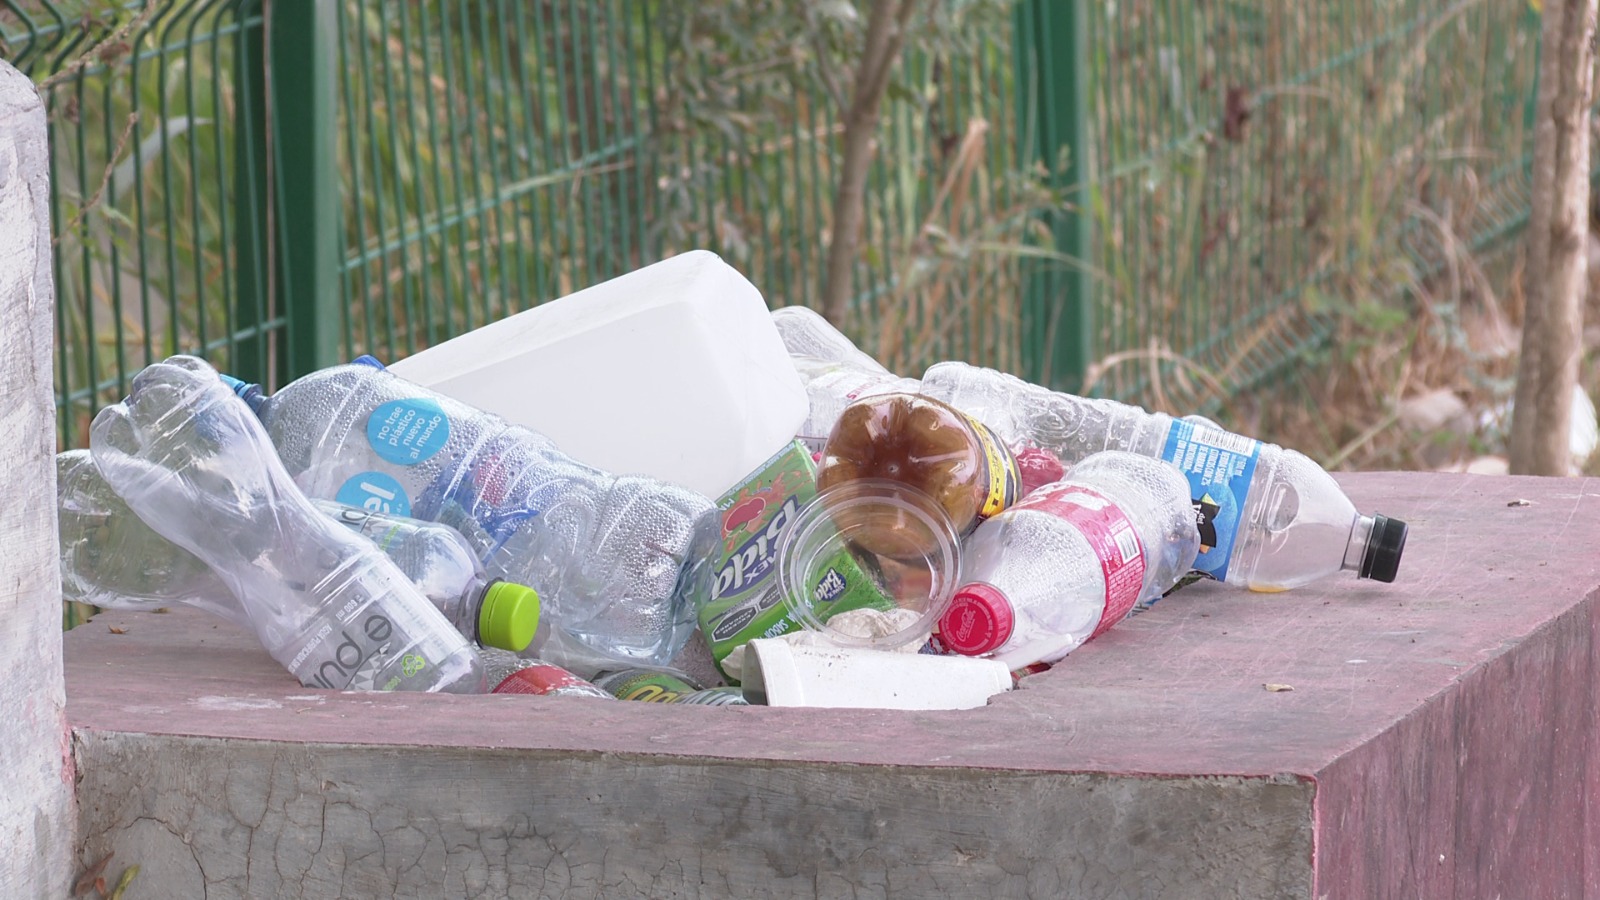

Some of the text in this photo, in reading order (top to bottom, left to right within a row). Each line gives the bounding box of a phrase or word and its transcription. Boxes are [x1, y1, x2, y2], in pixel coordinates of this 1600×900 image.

[377, 406, 404, 440] no trae
[388, 409, 416, 447] plástico
[402, 417, 426, 447] nuevo
[409, 415, 442, 459] al mundo
[1197, 512, 1206, 524] del
[815, 569, 842, 601] Bida
[335, 598, 358, 621] 600 ml
[316, 623, 333, 640] AGUA
[303, 631, 363, 690] pur
